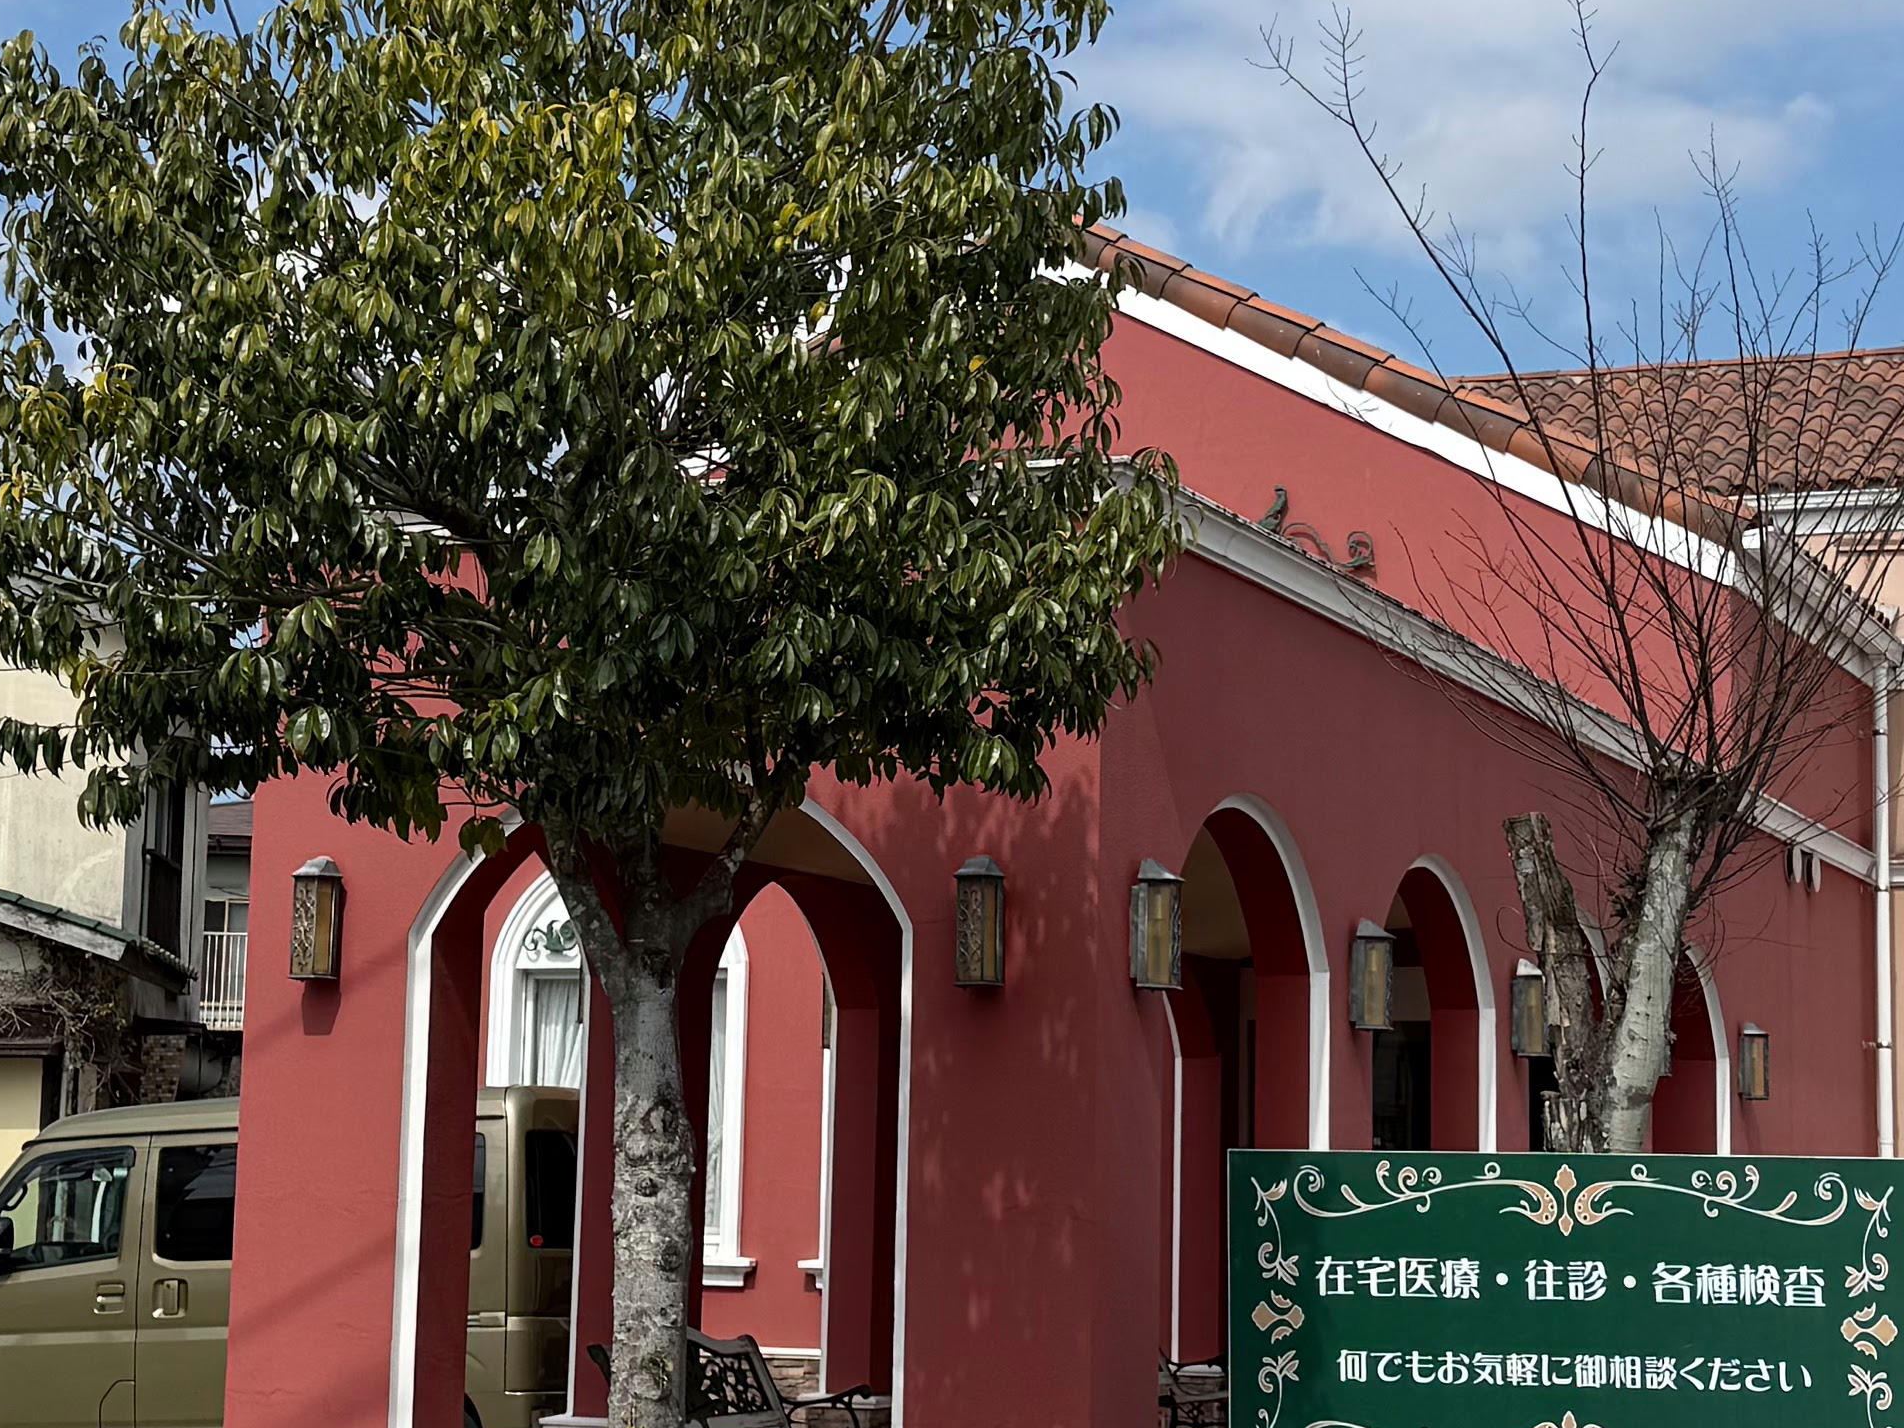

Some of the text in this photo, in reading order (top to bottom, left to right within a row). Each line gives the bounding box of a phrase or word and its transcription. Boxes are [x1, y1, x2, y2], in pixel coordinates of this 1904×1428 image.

[1314, 1255, 1827, 1310] 在宅医療・往診・各種検査
[1336, 1349, 1814, 1394] 何でもお気軽に御相談ください
